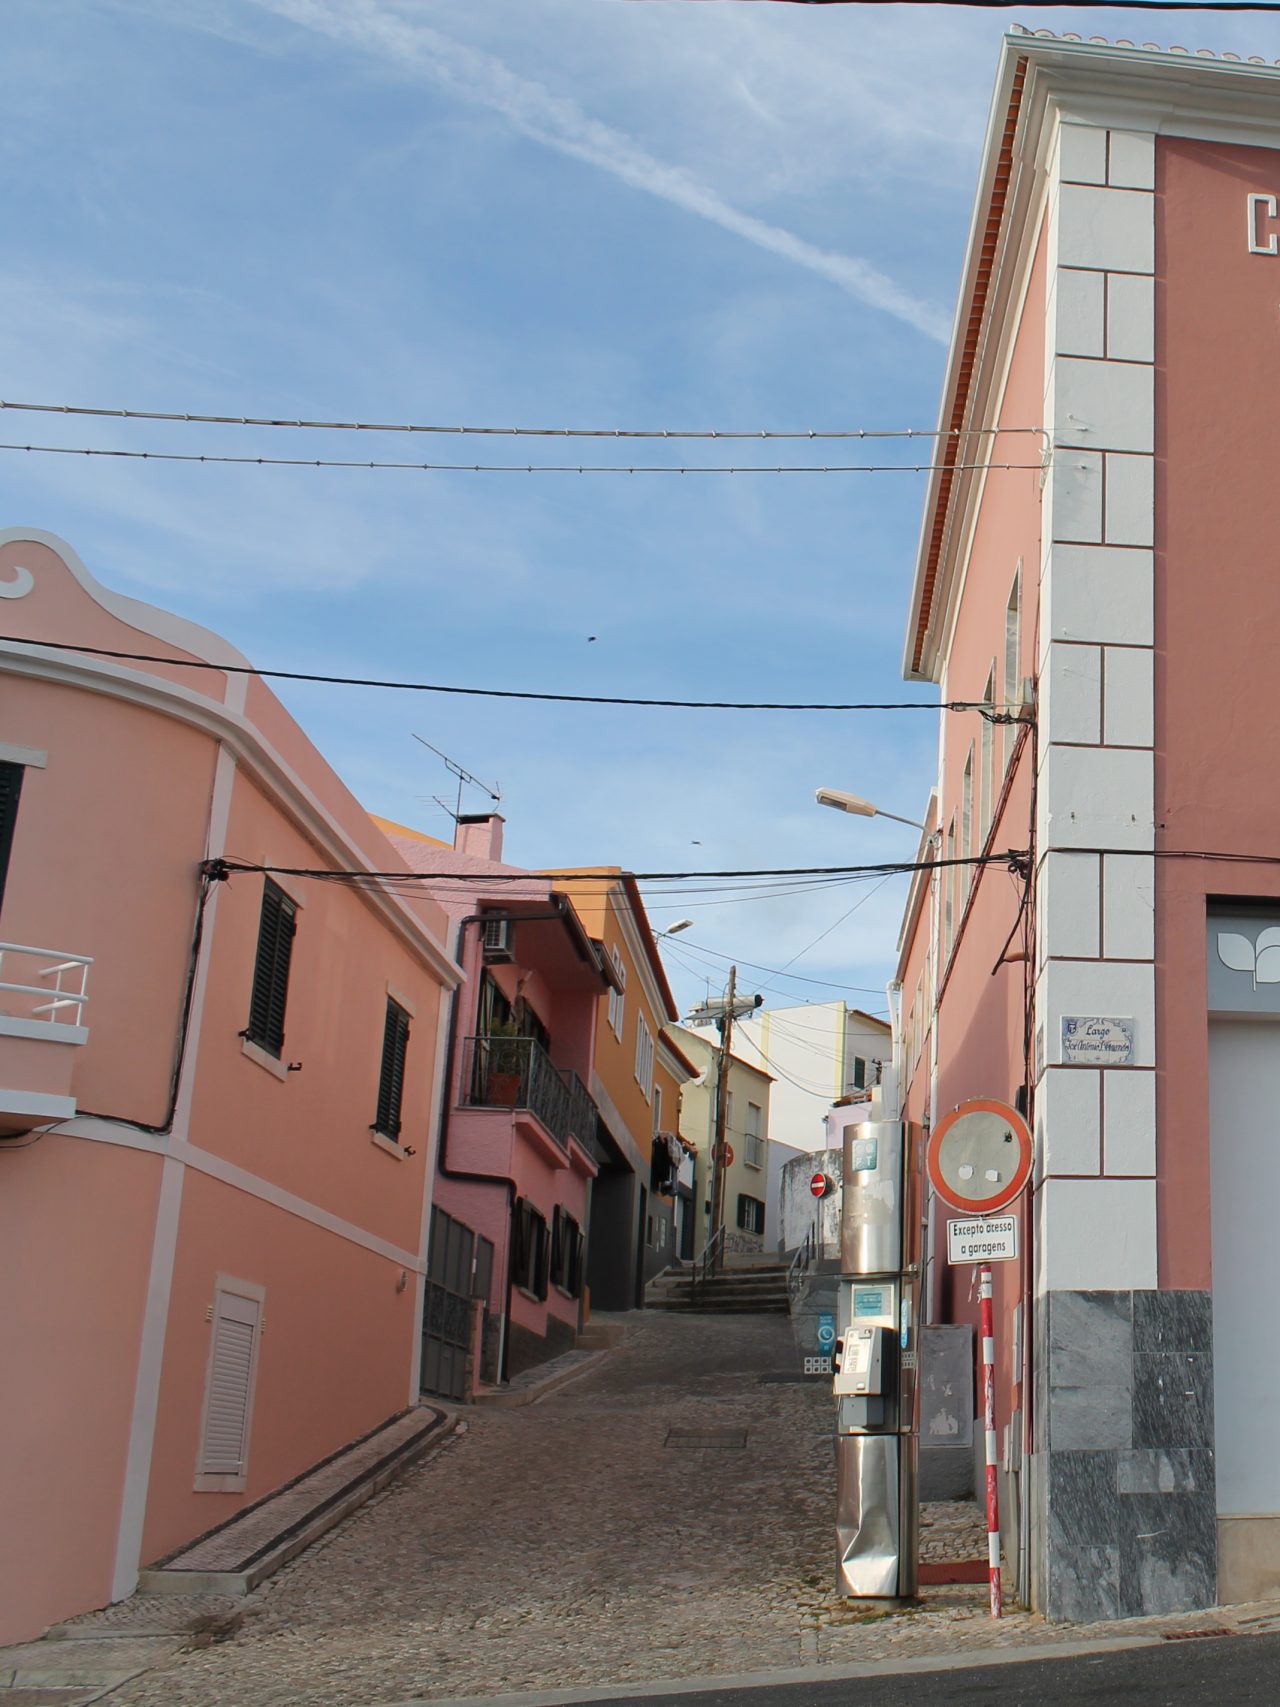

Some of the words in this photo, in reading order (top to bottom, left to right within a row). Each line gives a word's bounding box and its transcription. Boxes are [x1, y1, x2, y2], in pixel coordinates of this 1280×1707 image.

[1086, 1024, 1111, 1041] Largo
[953, 1223, 984, 1238] Excepto
[986, 1222, 1012, 1234] acesso
[961, 1245, 966, 1254] a
[968, 1242, 1006, 1256] garagens
